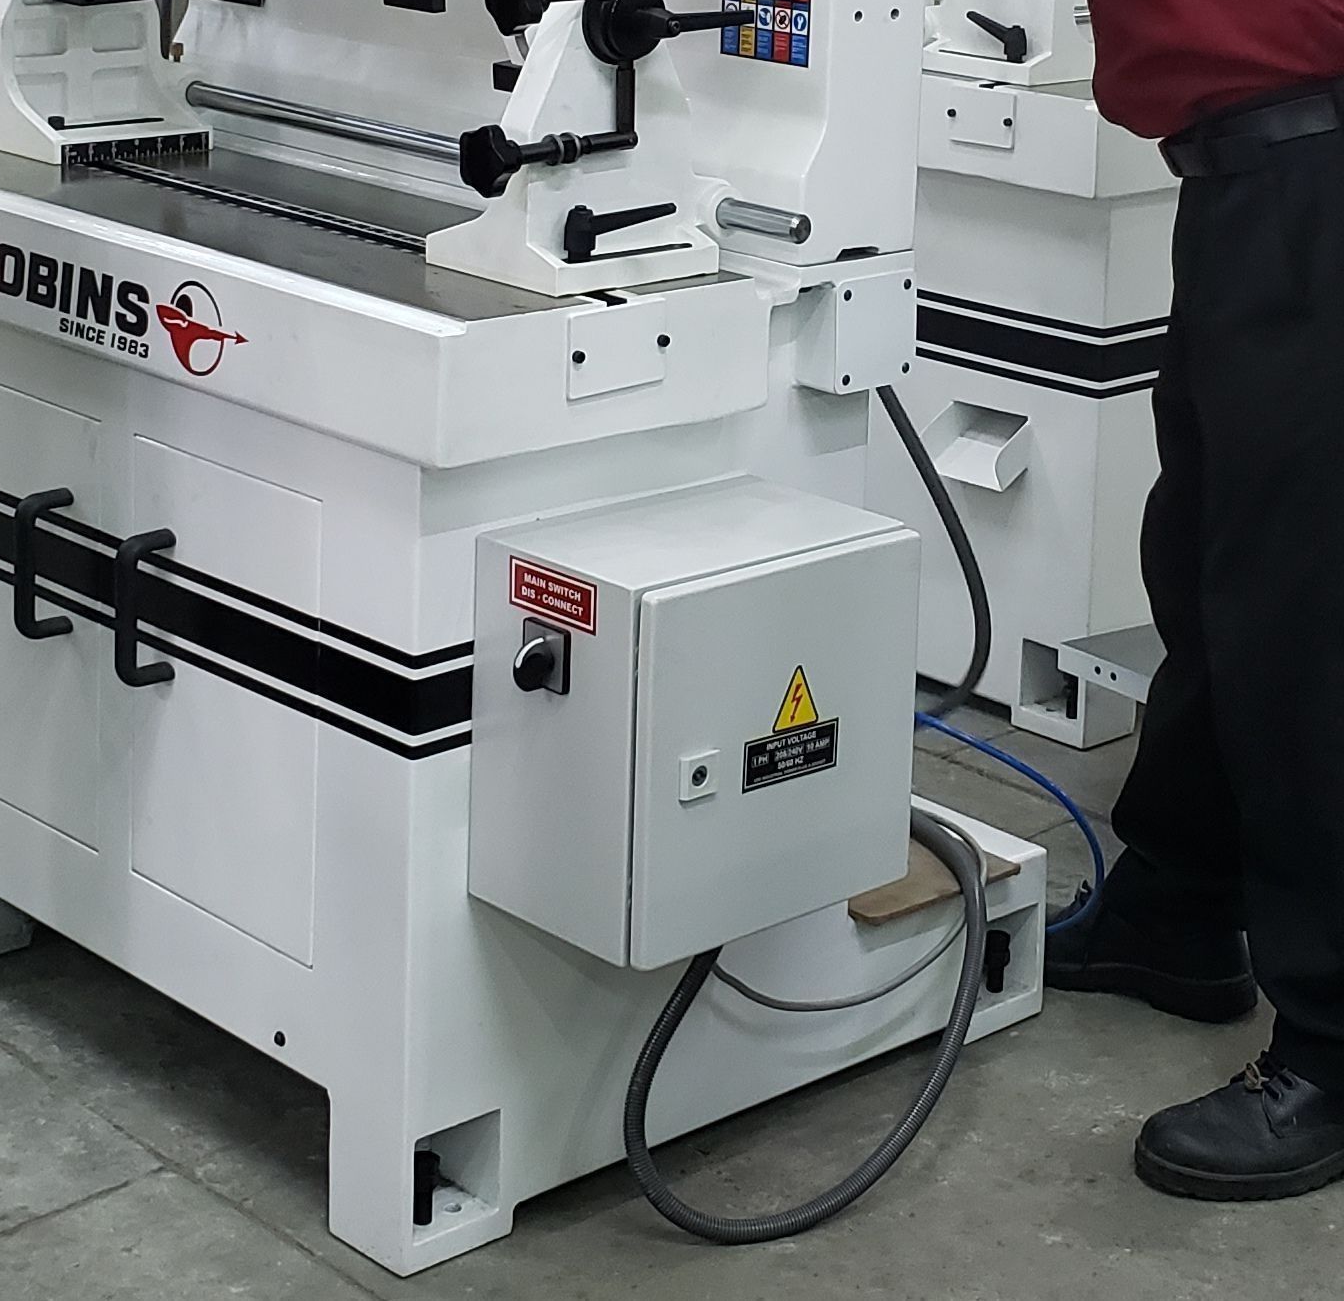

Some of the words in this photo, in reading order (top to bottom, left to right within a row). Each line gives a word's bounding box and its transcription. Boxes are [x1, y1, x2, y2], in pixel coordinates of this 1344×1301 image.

[59, 317, 106, 346] SINCE
[110, 333, 149, 359] 1983
[521, 586, 536, 599] DIS
[542, 594, 584, 617] CONNECT
[523, 572, 546, 589] MAIN
[548, 582, 581, 602] SWITCH
[766, 739, 786, 751] INPUT
[787, 731, 817, 746] VOLTAGE
